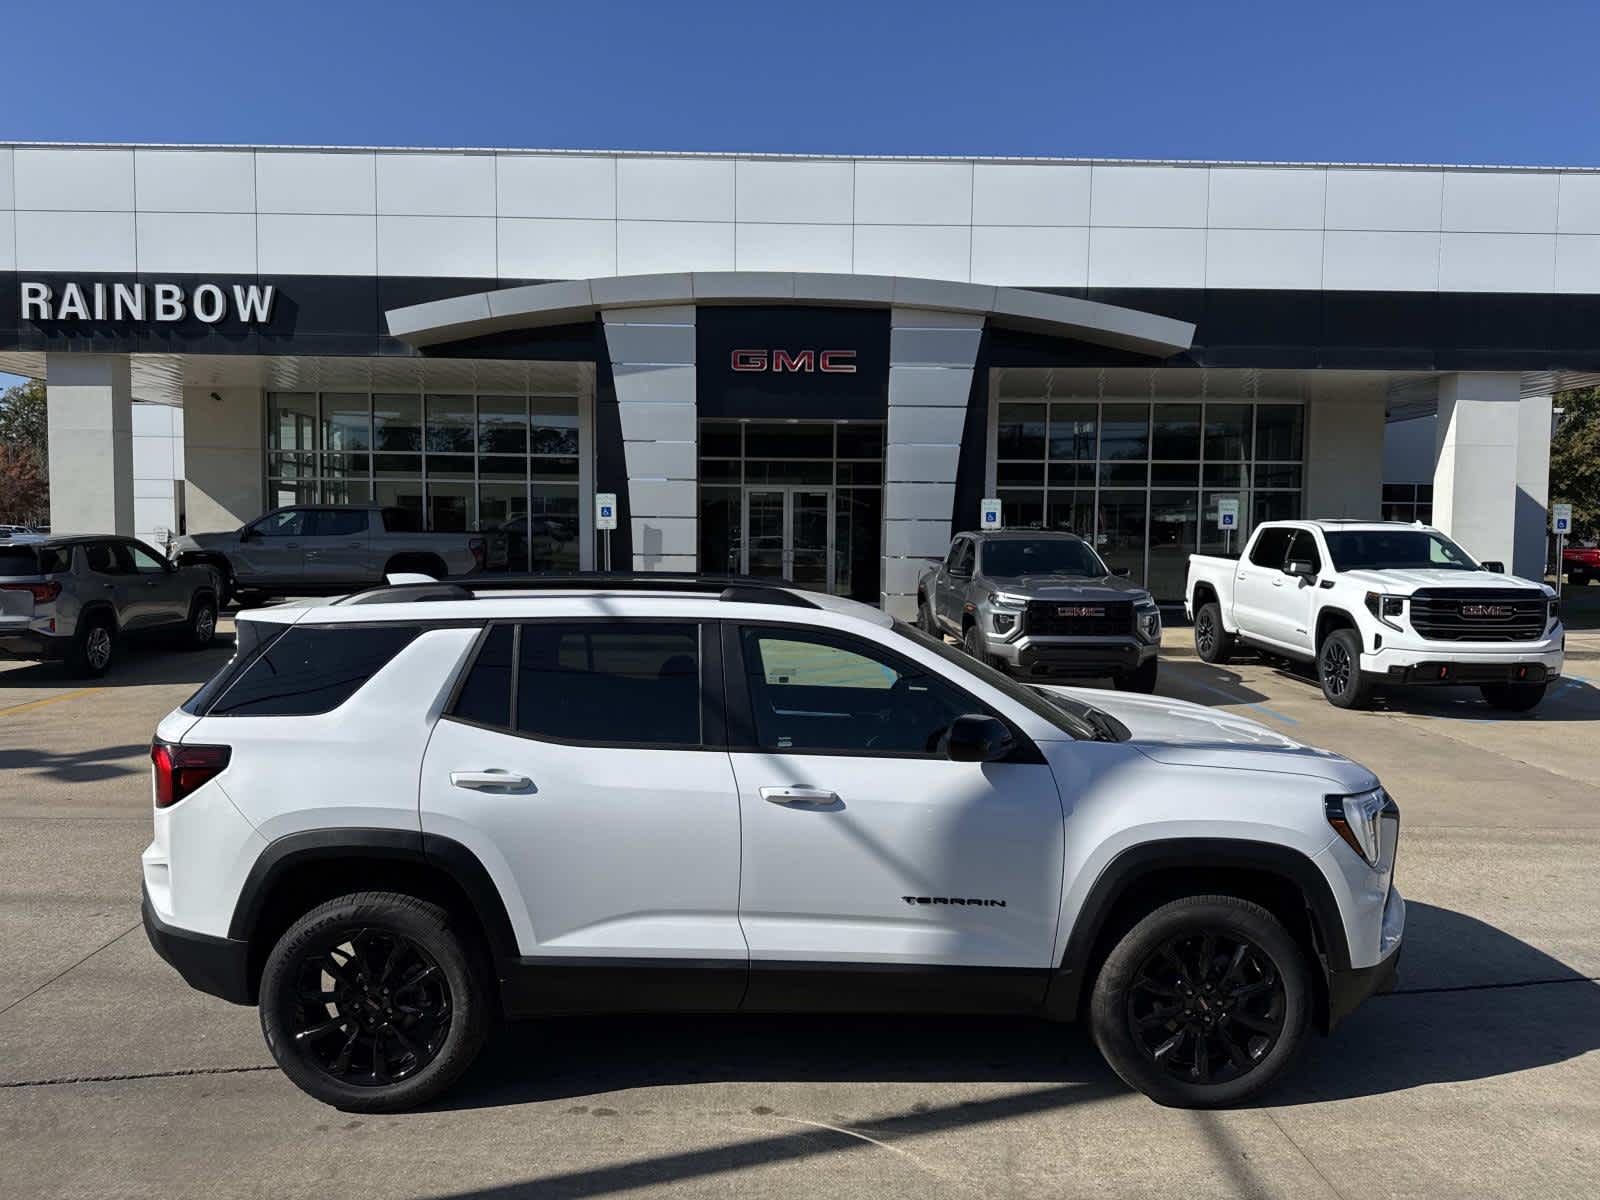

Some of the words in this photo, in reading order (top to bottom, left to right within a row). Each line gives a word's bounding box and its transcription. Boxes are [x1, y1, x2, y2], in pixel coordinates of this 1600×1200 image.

[21, 281, 276, 324] RAINBOW
[731, 350, 858, 373] GMC
[1057, 606, 1106, 617] GMC
[1461, 605, 1513, 617] GMC
[902, 896, 1007, 907] TERRAIN
